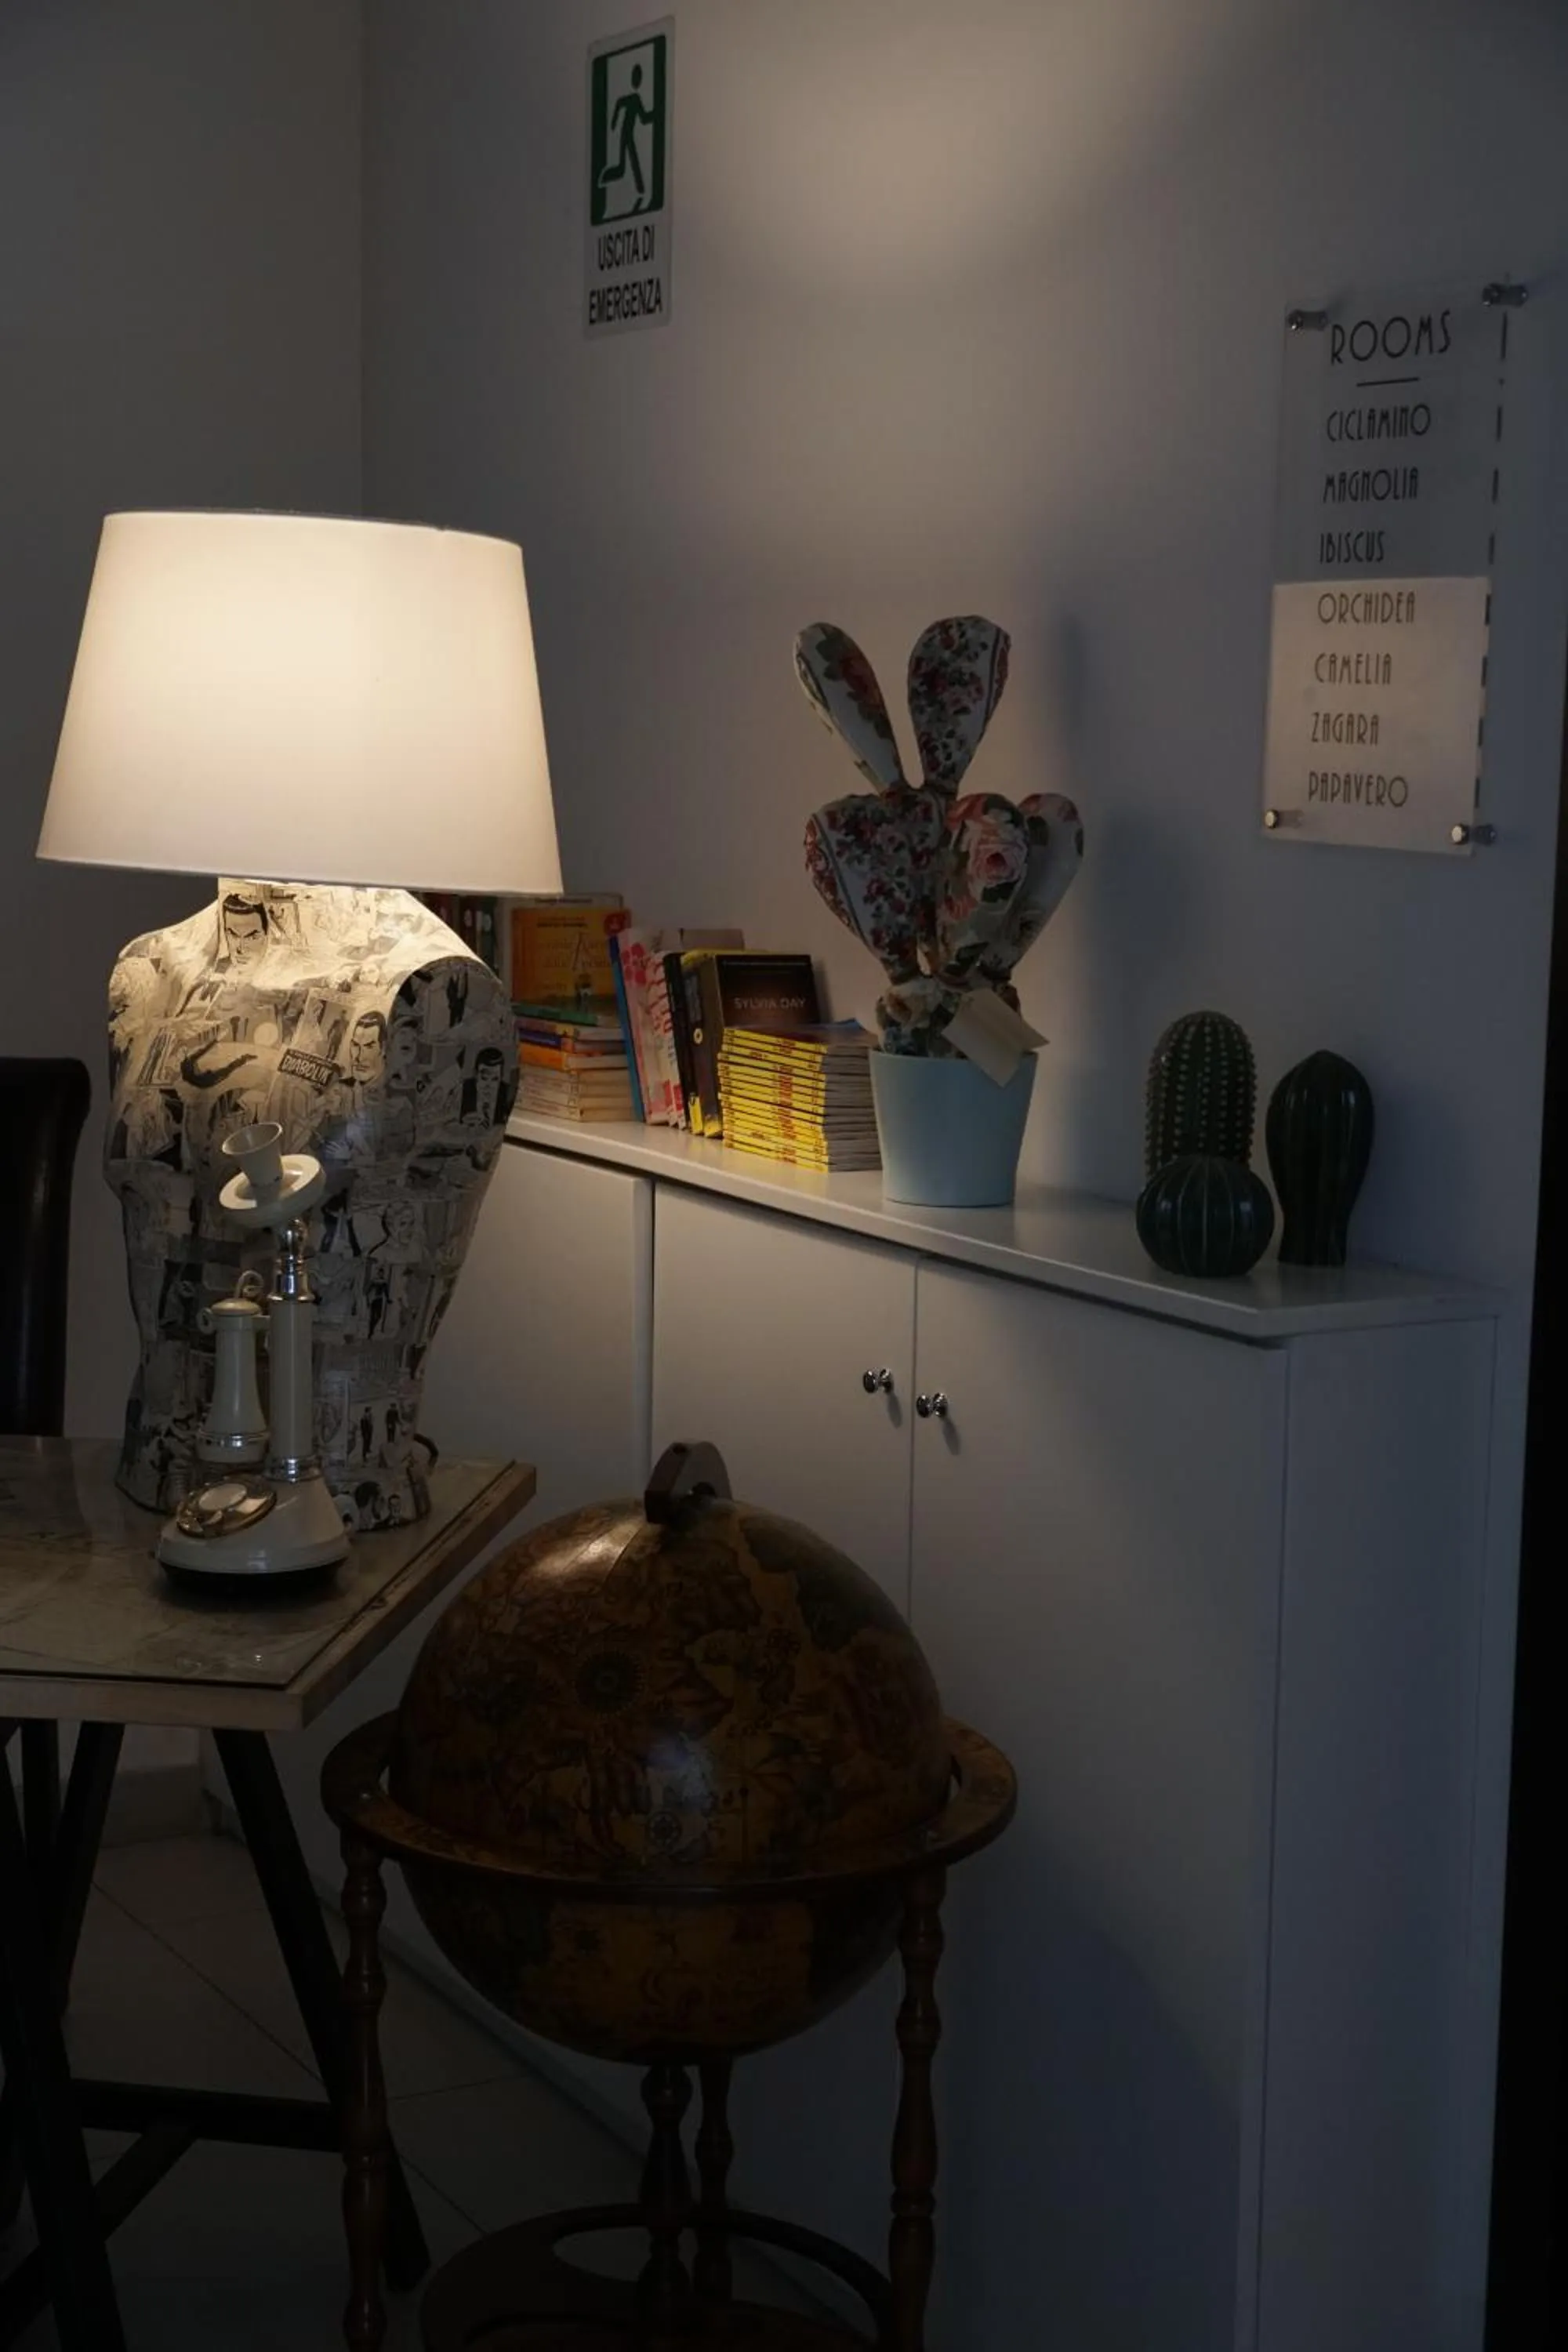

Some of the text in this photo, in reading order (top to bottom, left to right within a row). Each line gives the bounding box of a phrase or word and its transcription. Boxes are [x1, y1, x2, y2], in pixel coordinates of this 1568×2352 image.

[598, 224, 655, 270] USCITA DI
[589, 277, 662, 325] EMERGENZA
[1331, 310, 1450, 365] ROOMS
[1327, 404, 1431, 441] CICLAMINO
[1323, 467, 1418, 503] MAGNOLIA
[1319, 531, 1385, 564] IBISCUS
[1318, 591, 1415, 624] ORCHIDEA
[1315, 652, 1392, 685] CAMELIA
[1311, 712, 1380, 746] ZAGARA
[1308, 771, 1409, 808] PAPAVERO
[734, 996, 807, 1010] SYLVIA DAY
